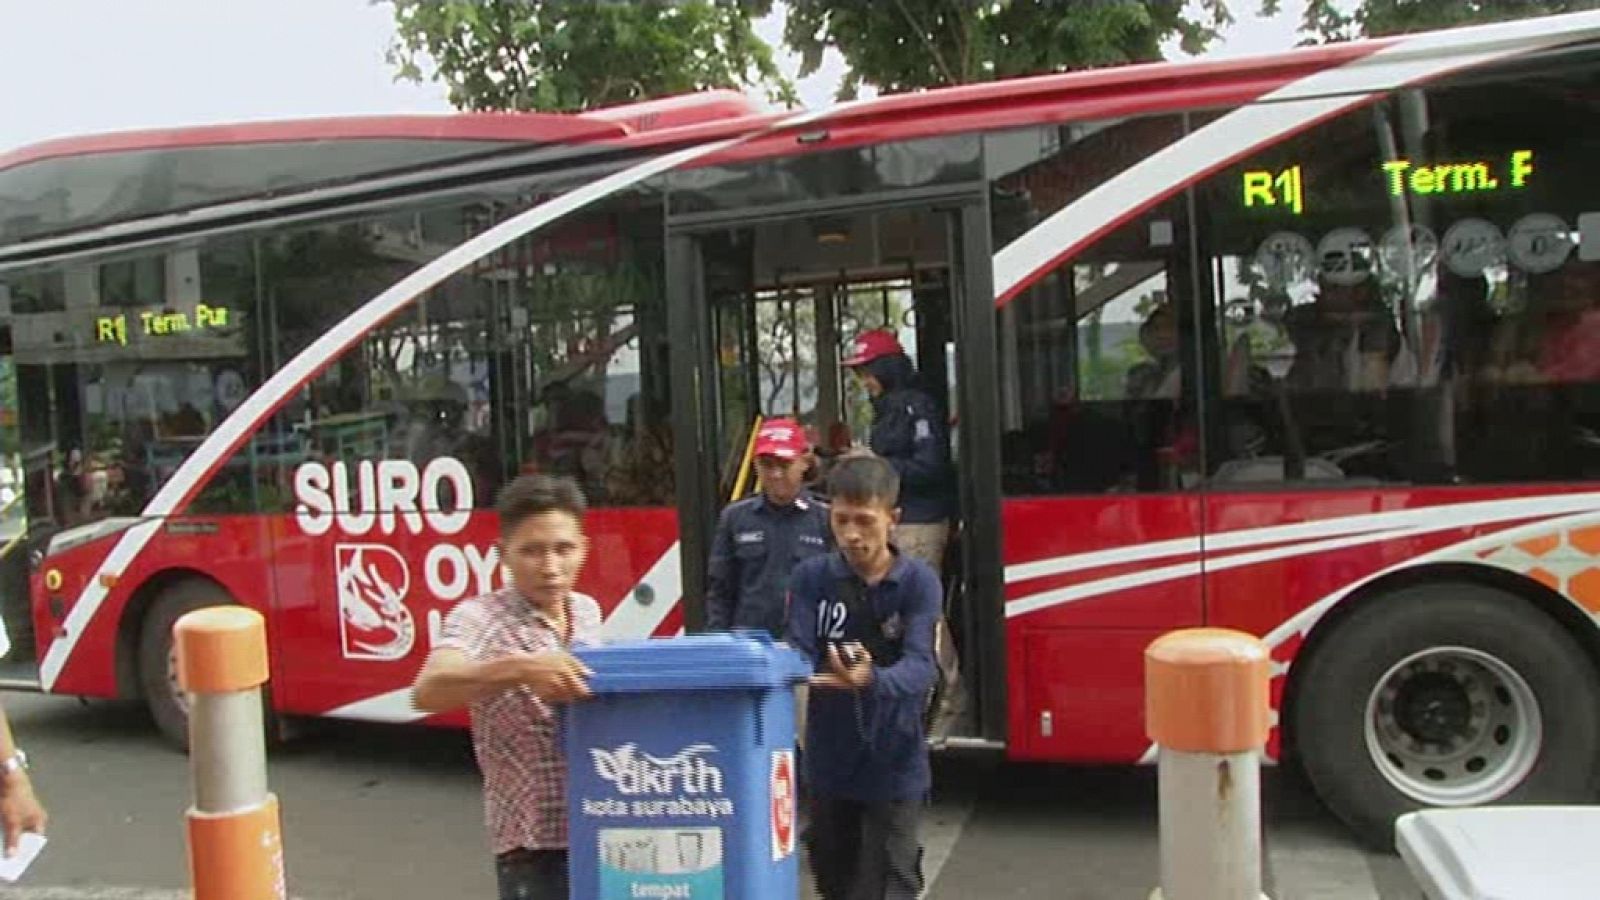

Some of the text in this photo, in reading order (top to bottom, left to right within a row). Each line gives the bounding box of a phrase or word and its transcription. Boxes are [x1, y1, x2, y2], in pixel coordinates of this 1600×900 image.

[1384, 160, 1497, 195] Term.
[141, 312, 191, 333] Term.
[294, 456, 473, 535] SURO
[424, 543, 513, 600] OY
[631, 796, 734, 820] surabaya
[631, 881, 690, 900] tempat
